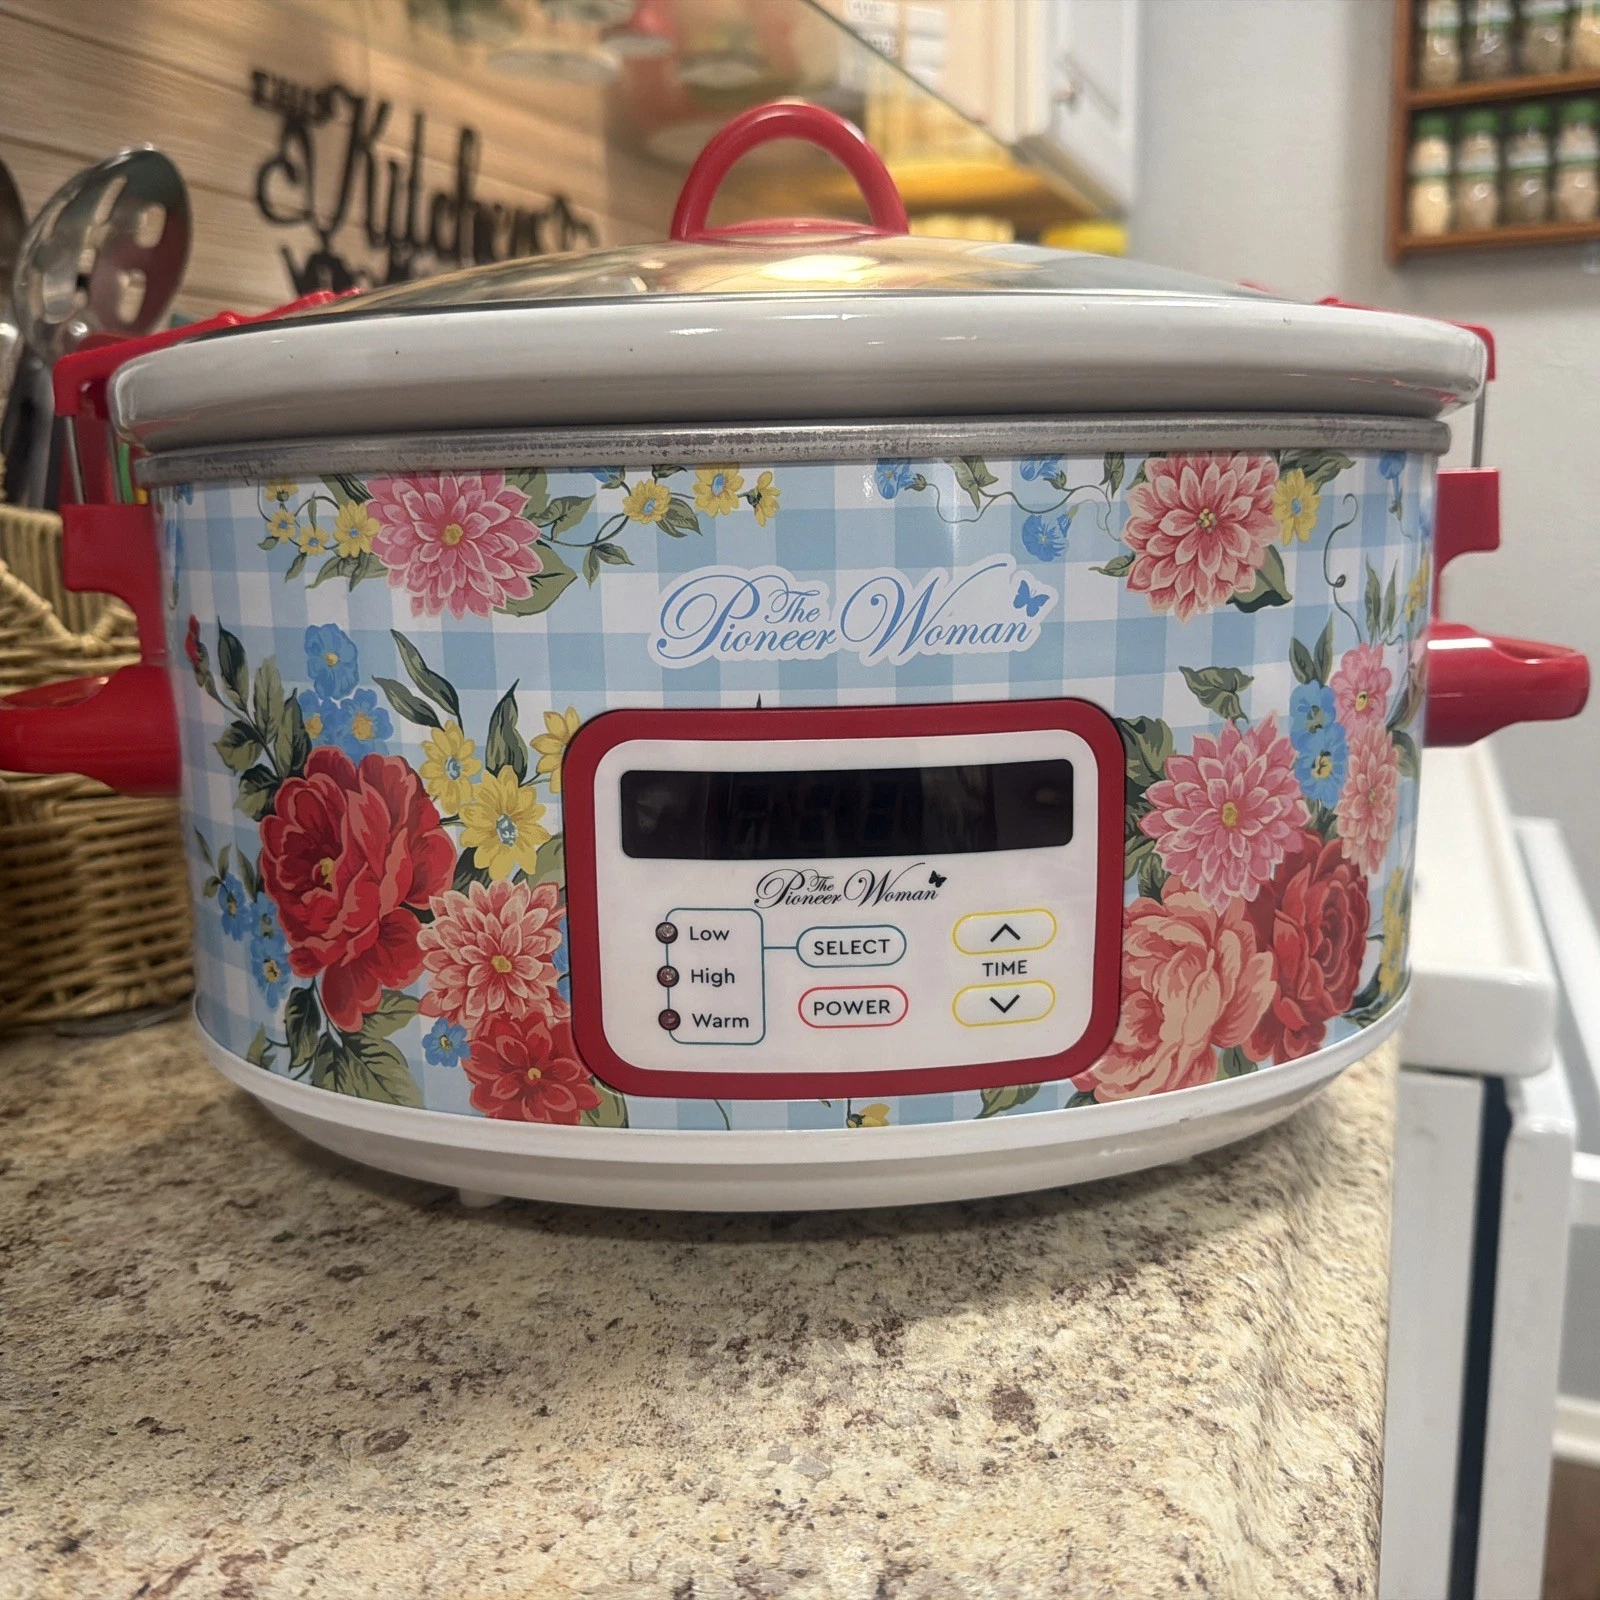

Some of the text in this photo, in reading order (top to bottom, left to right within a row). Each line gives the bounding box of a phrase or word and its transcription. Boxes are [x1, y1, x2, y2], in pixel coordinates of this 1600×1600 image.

[656, 562, 1033, 661] The Pioneer Woman
[754, 862, 940, 910] The Pioneer Woman
[689, 926, 730, 942] Low
[813, 939, 891, 956] SELECT
[982, 959, 1028, 977] TIME
[690, 968, 736, 987] High
[813, 999, 891, 1018] POWER
[692, 1013, 750, 1029] Warm
